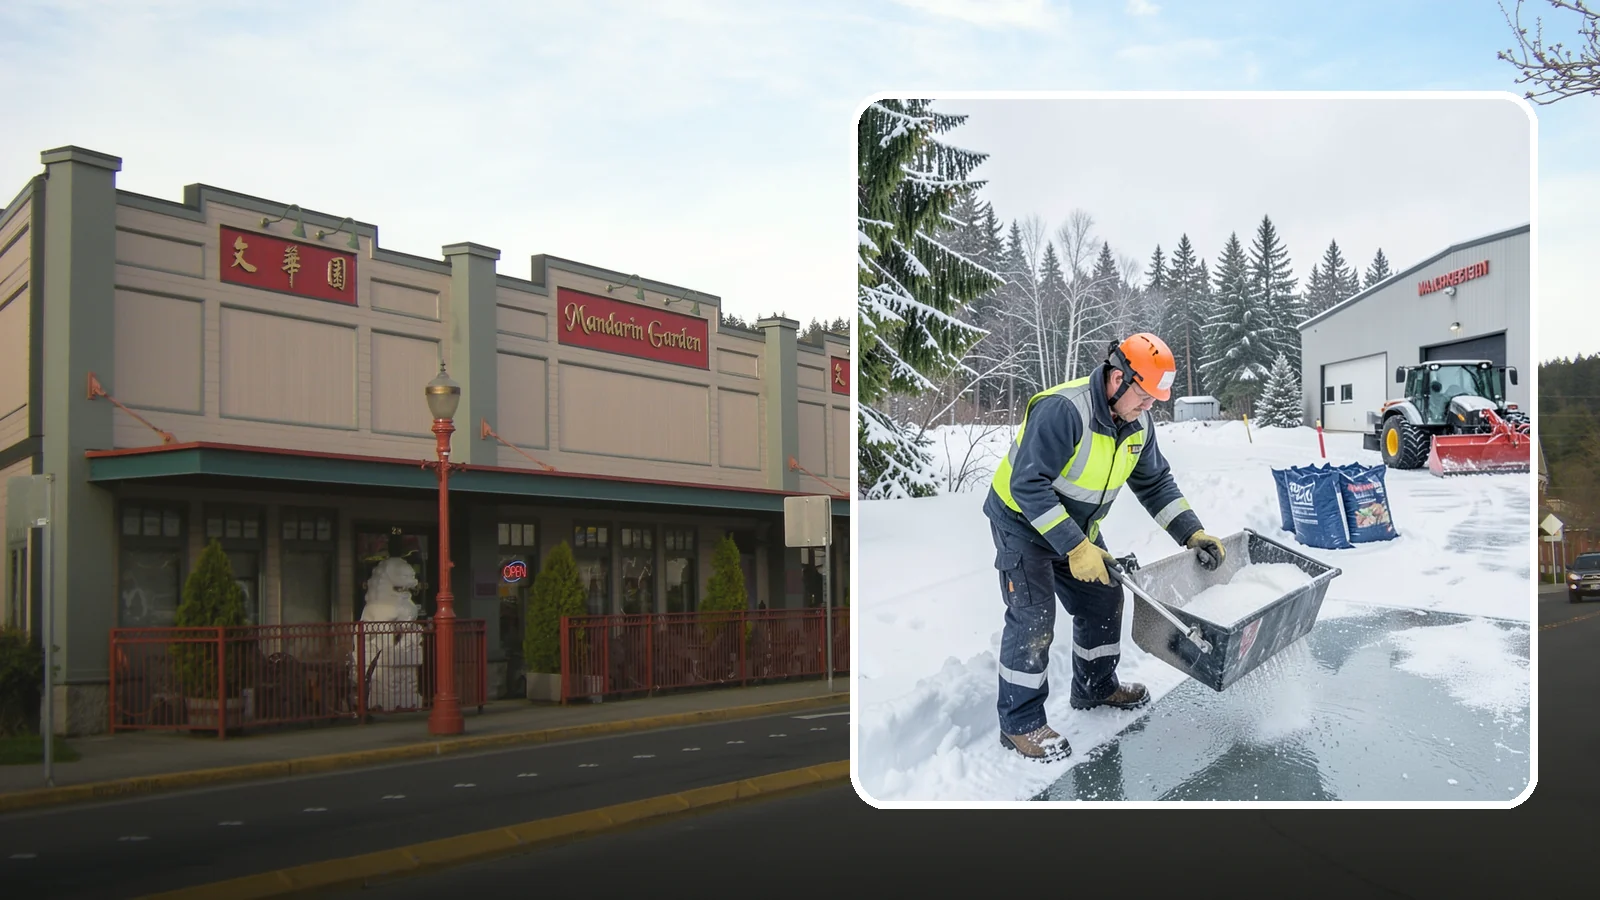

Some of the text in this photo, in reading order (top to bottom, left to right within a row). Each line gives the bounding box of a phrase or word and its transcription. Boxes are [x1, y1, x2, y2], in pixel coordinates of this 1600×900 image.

[230, 235, 346, 291] 文華園
[564, 302, 702, 352] Mandarin Garden
[503, 564, 527, 579] OPEN
